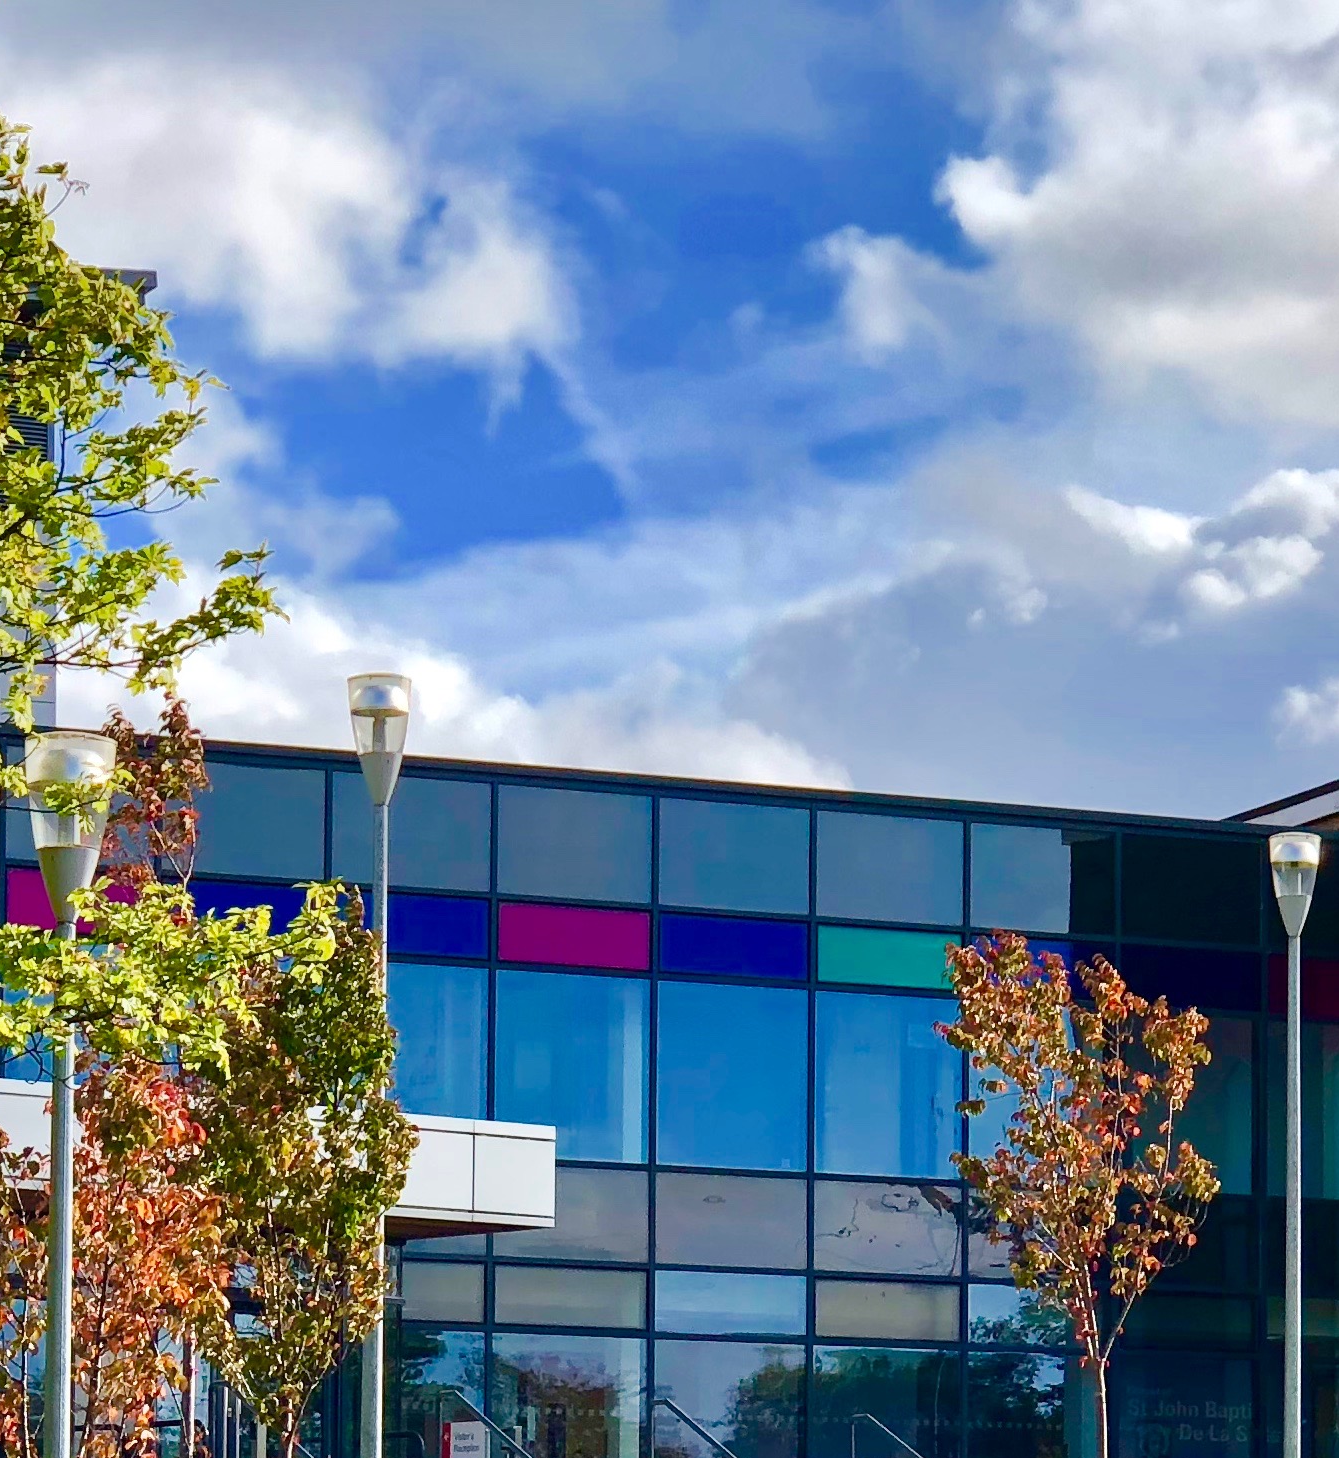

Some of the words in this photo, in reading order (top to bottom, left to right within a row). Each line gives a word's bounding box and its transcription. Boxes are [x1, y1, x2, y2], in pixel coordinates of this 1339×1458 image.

[1154, 1400, 1199, 1418] John
[1205, 1401, 1253, 1422] Bapti
[1179, 1424, 1203, 1441] De
[1209, 1424, 1230, 1442] La
